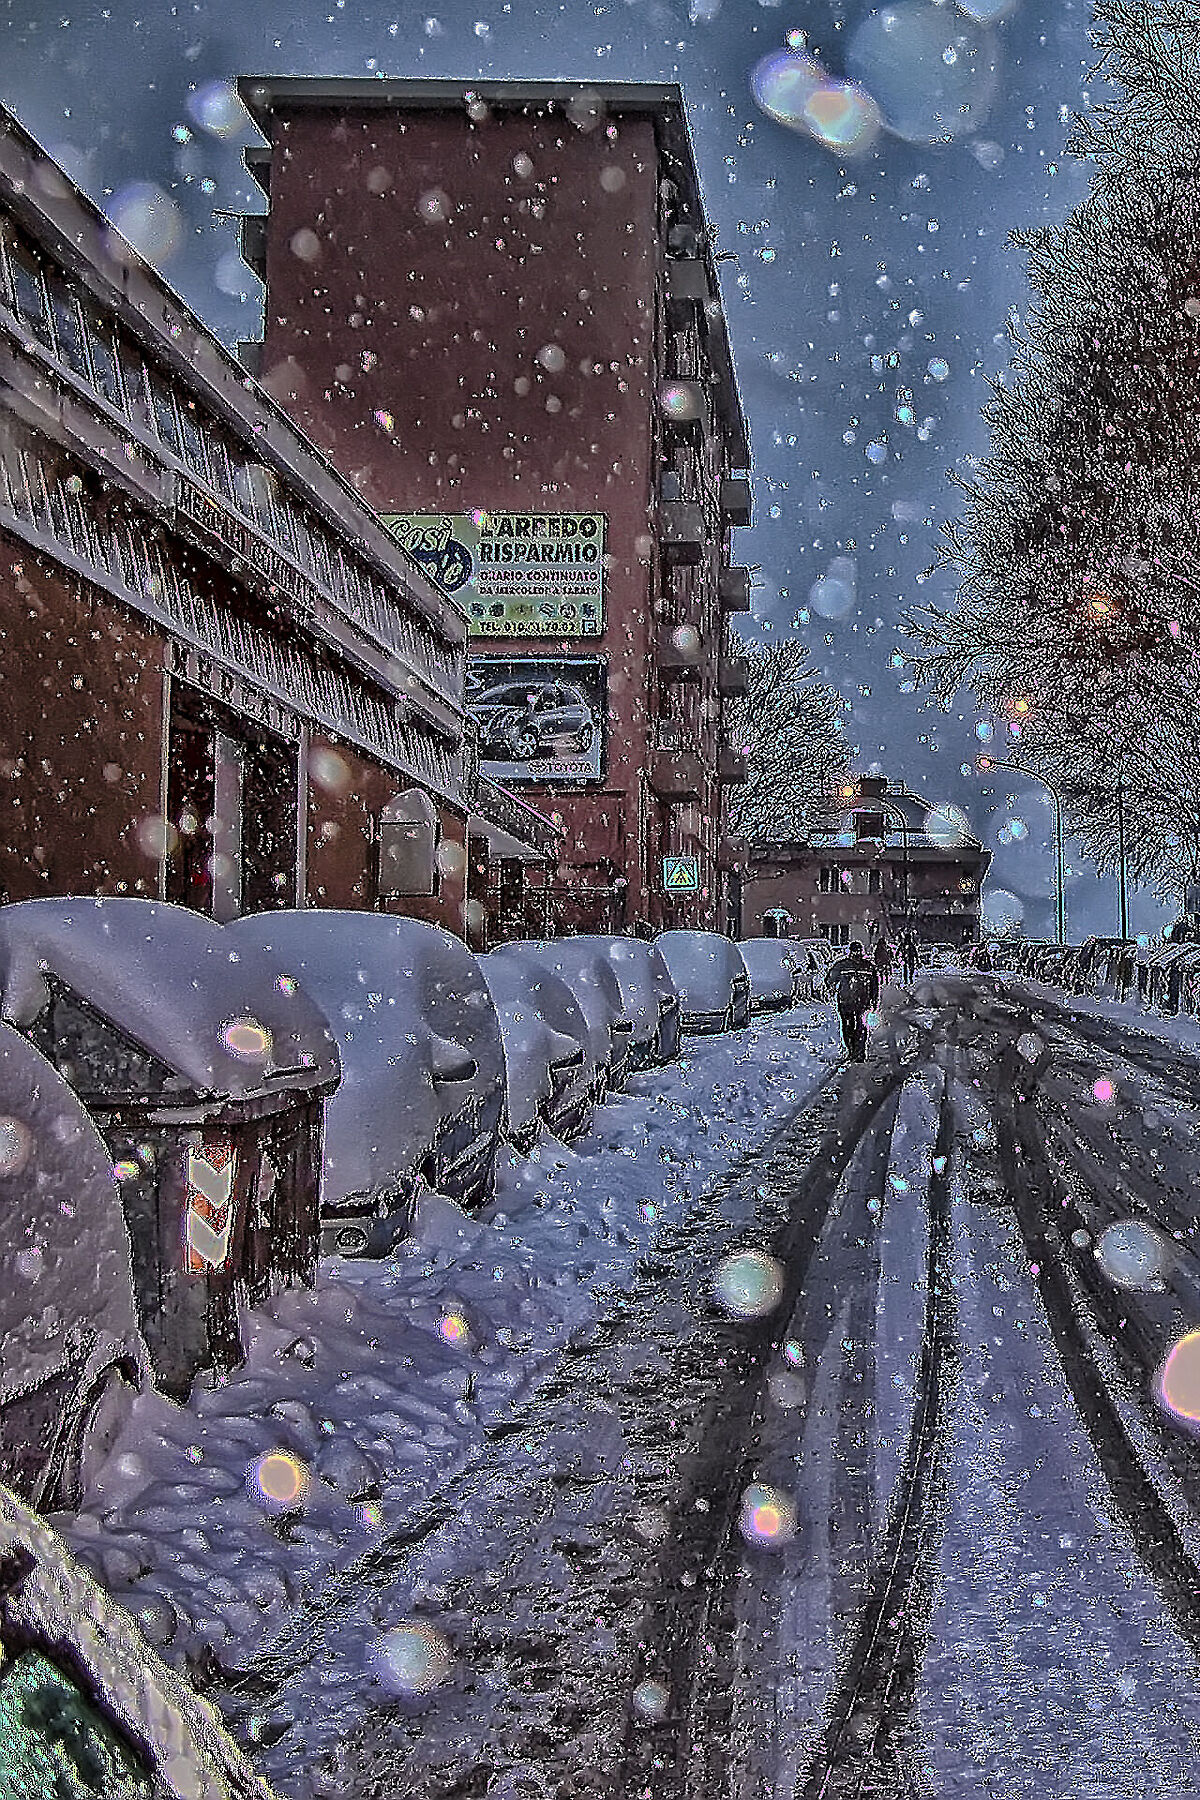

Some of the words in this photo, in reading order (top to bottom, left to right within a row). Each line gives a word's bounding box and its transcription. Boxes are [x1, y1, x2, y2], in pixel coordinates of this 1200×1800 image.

[480, 517, 598, 538] L'ARREDO
[480, 543, 598, 563] RISPARMIO
[480, 570, 523, 581] ORARIO
[526, 570, 598, 581] CONTINUATO
[480, 586, 493, 595] DA
[480, 621, 500, 632] TEL.
[545, 763, 594, 773] TOYOTA
